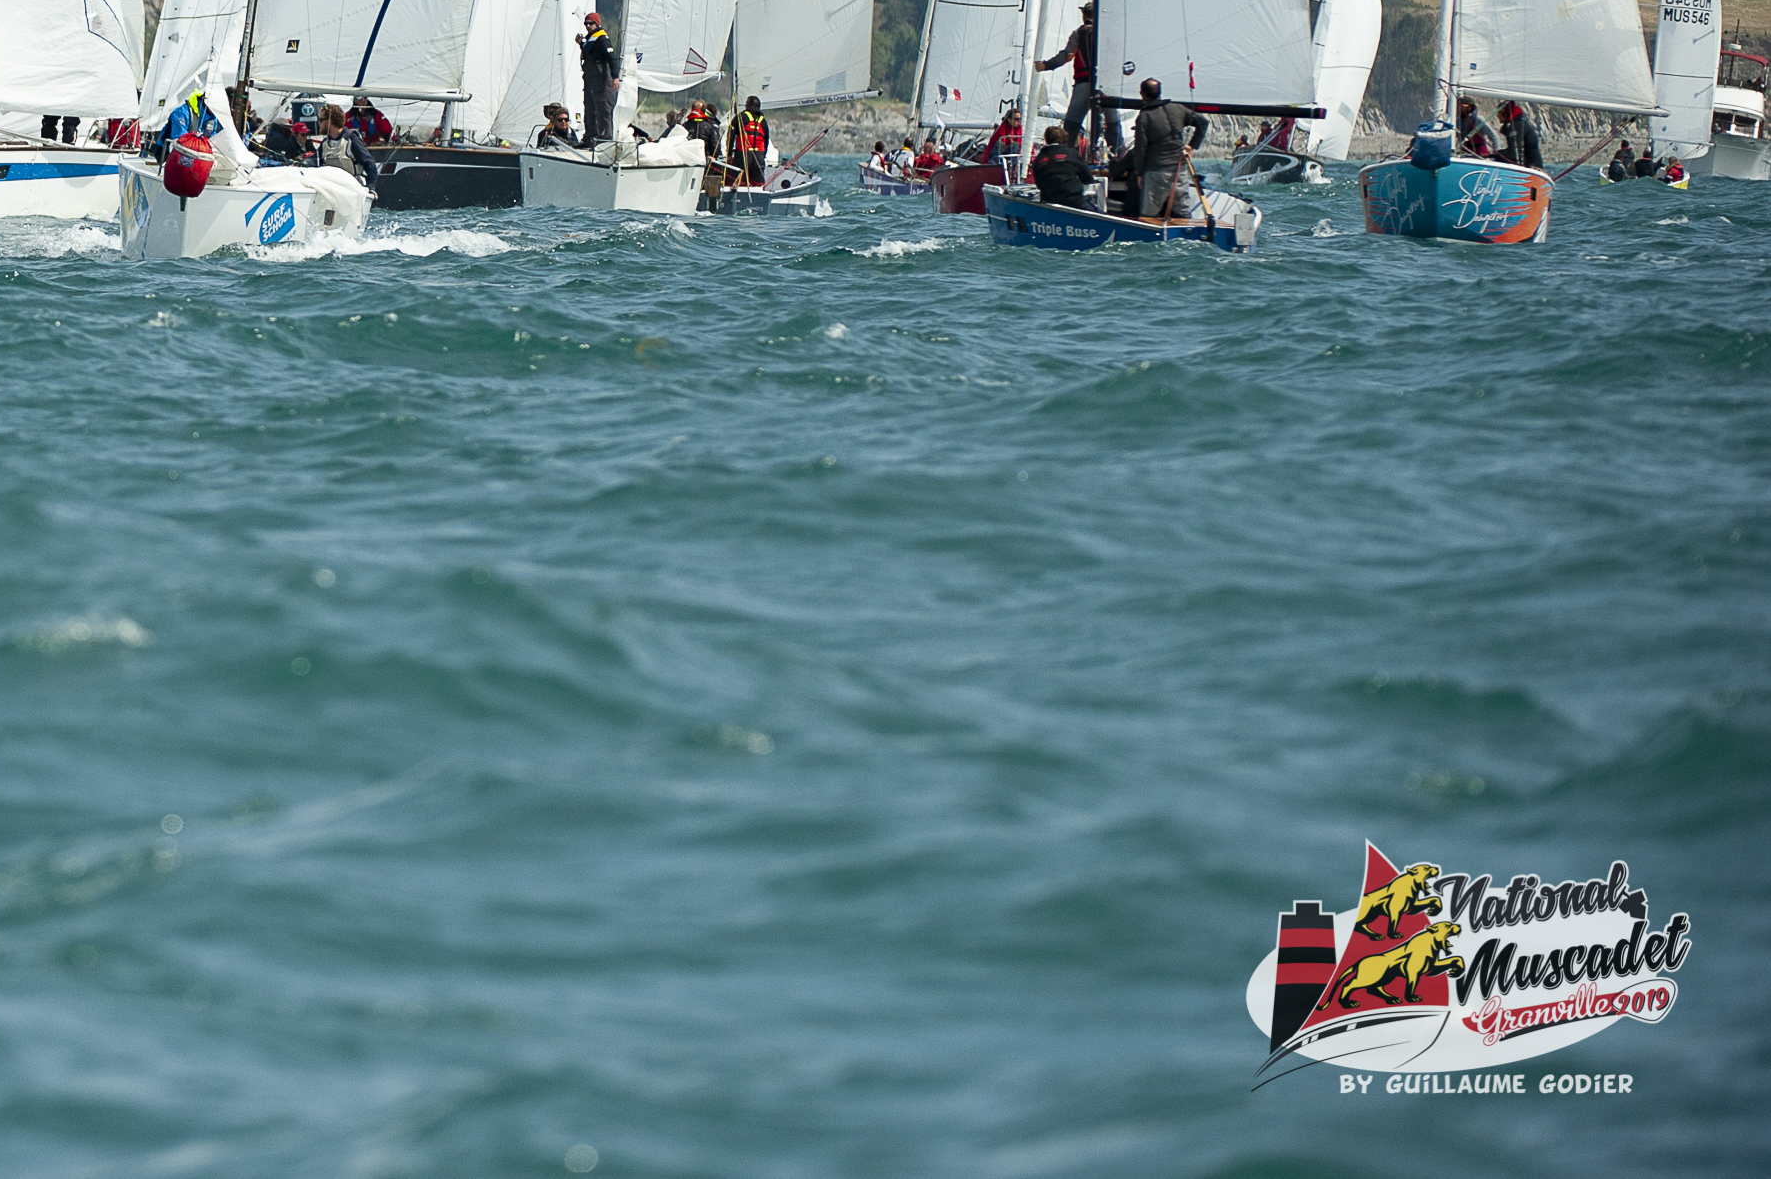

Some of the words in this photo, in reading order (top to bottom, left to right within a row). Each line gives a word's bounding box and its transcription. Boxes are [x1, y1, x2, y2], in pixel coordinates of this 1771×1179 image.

[262, 202, 286, 233] SURF
[263, 207, 293, 242] SCHOOL
[1030, 221, 1063, 237] Triple
